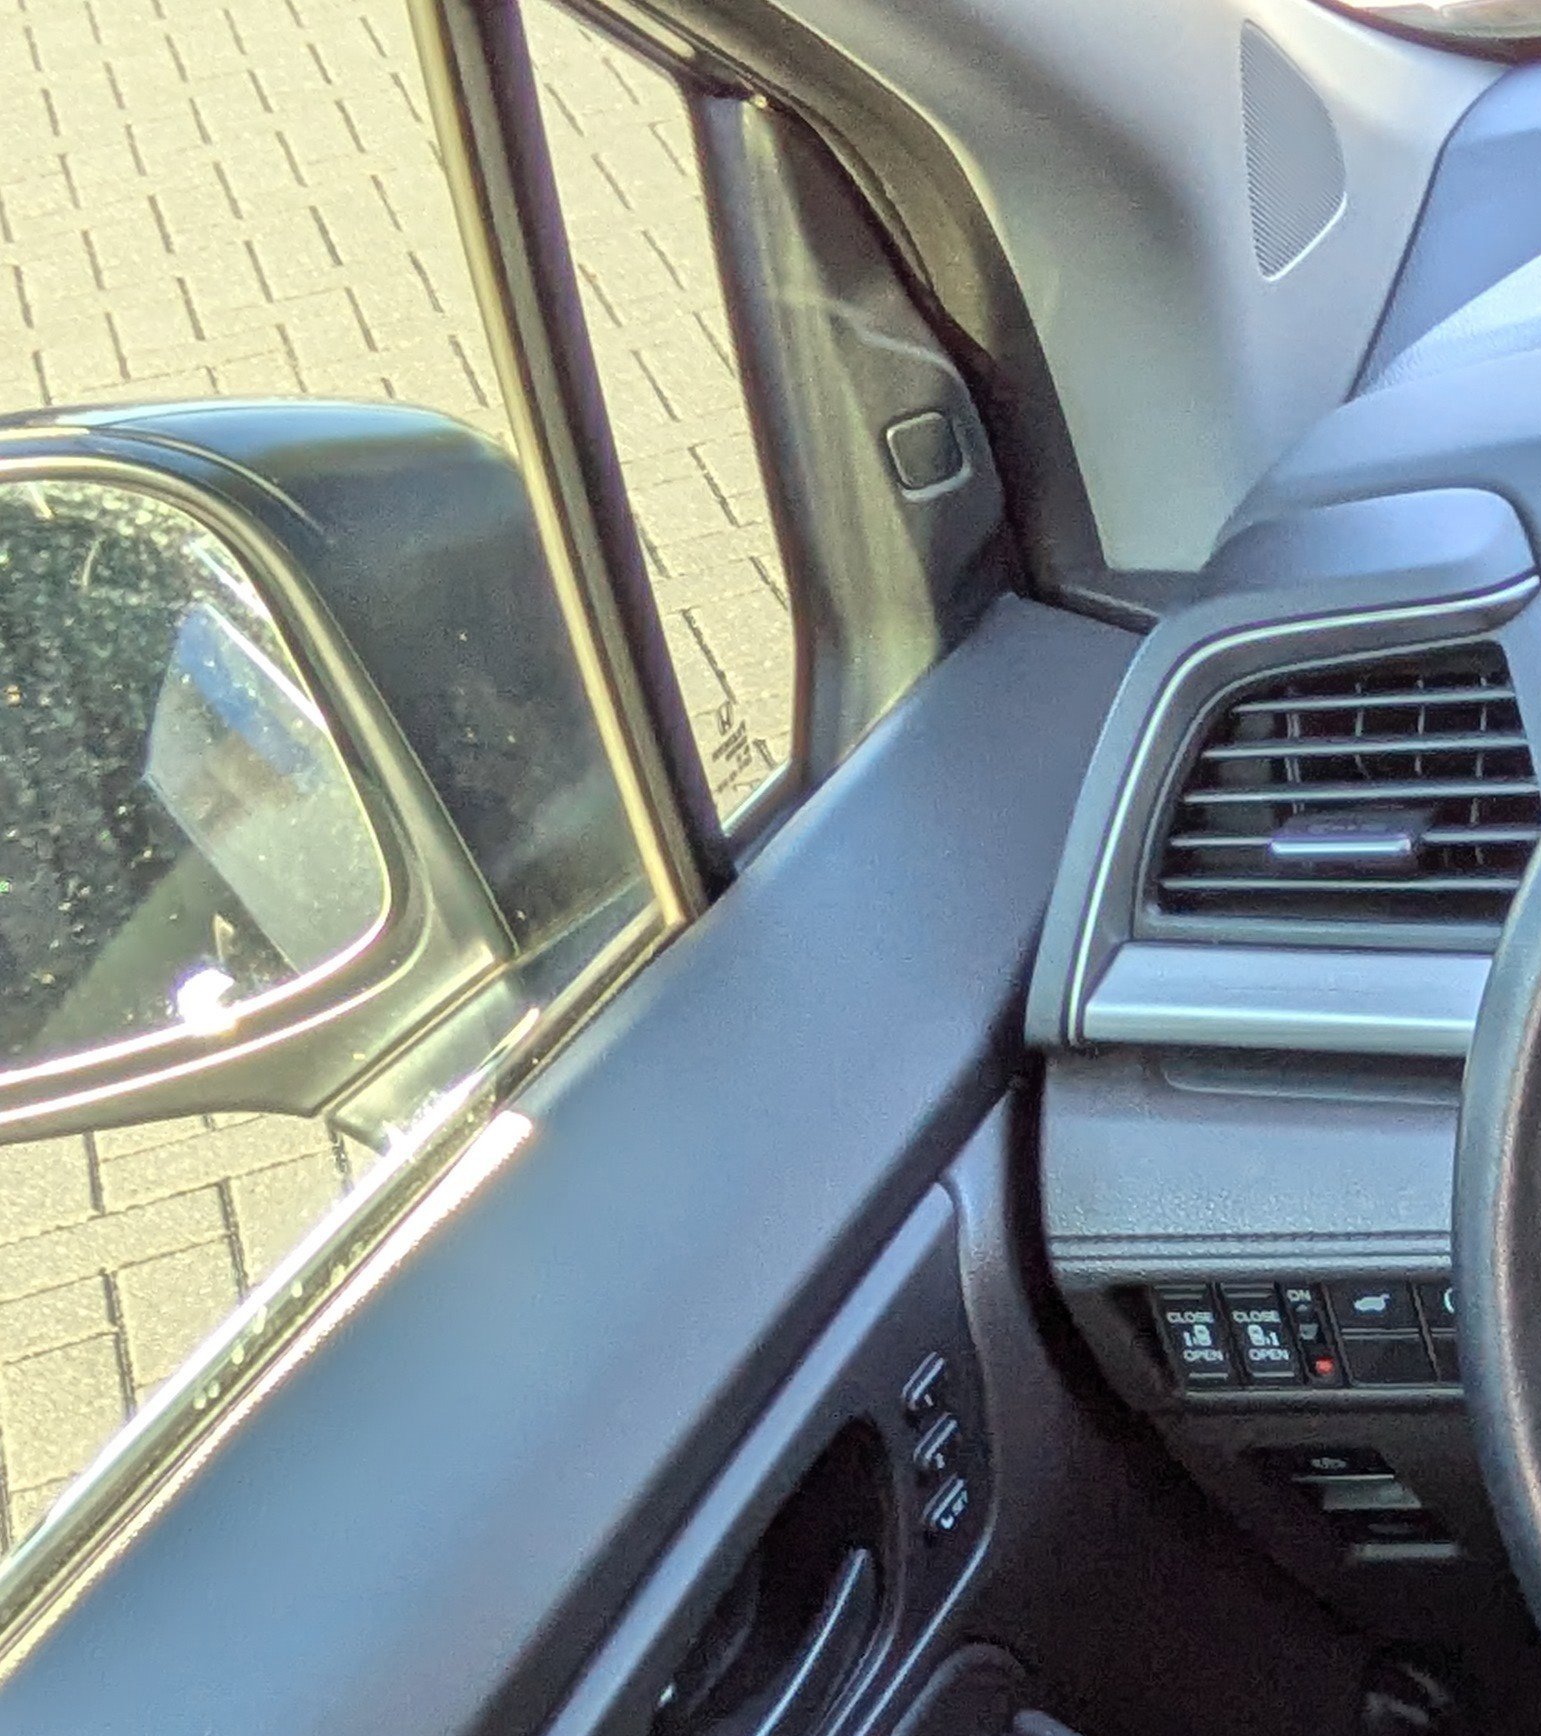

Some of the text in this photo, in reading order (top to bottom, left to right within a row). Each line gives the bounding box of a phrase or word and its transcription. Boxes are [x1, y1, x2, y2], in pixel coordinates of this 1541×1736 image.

[1286, 1289, 1312, 1303] ON
[1166, 1311, 1214, 1324] CLOSE
[1231, 1310, 1282, 1323] CLOSE
[1183, 1350, 1224, 1363] OPEN
[1249, 1348, 1290, 1362] OPEN
